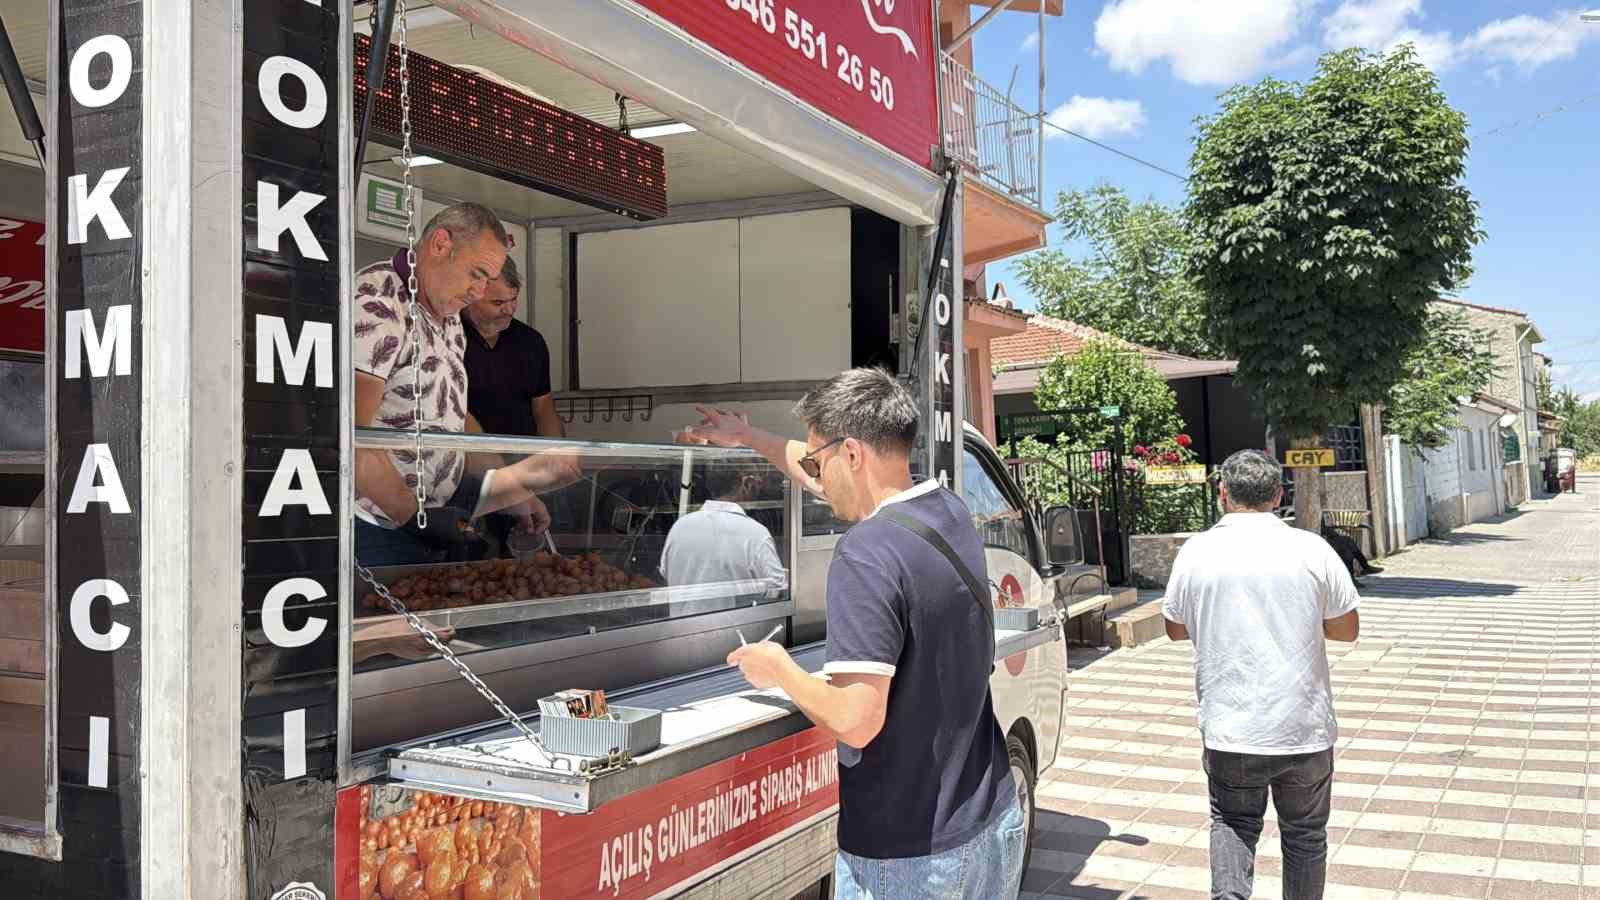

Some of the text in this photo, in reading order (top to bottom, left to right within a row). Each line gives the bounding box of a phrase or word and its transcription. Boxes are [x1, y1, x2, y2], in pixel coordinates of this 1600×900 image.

[725, 0, 894, 110] 46 551 26 50
[255, 0, 333, 780] OKMACI
[598, 823, 653, 897] AÇILIŞ
[657, 779, 758, 863] GÜNLERİNİZDE
[760, 754, 803, 815] SİPARİŞ
